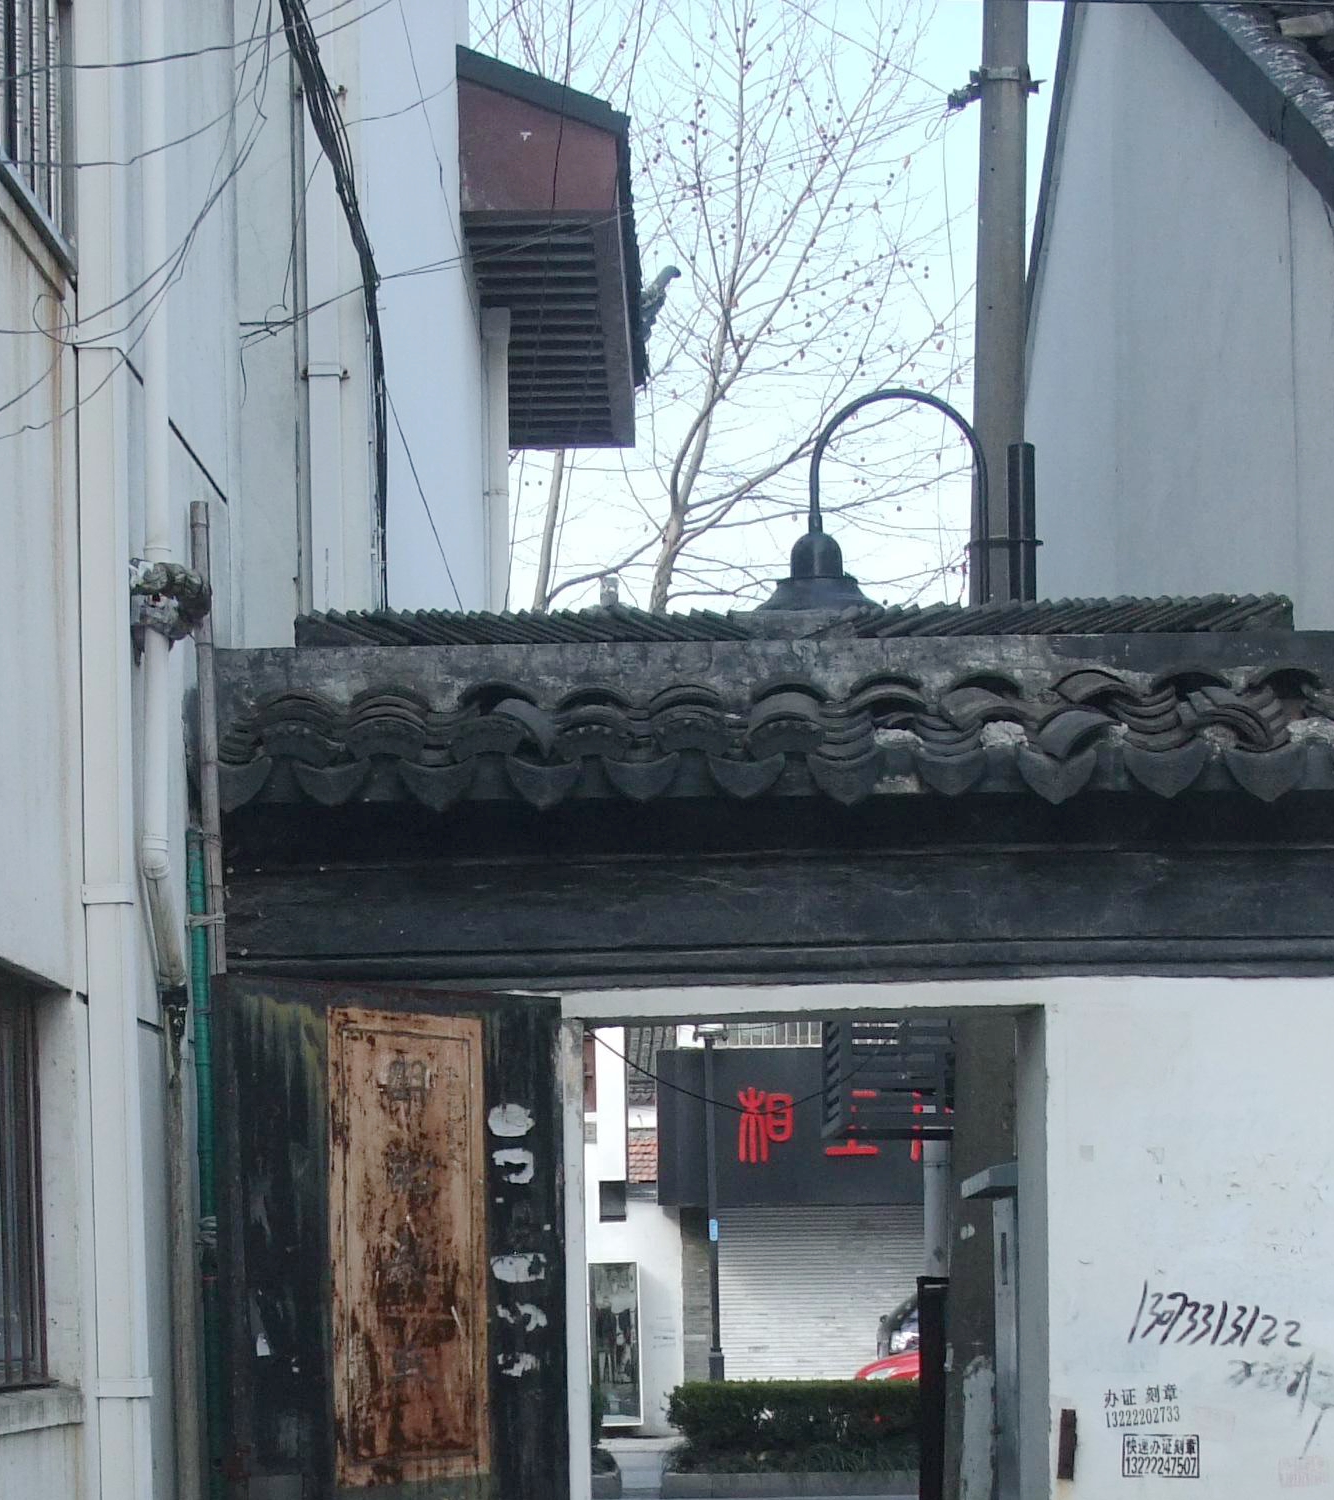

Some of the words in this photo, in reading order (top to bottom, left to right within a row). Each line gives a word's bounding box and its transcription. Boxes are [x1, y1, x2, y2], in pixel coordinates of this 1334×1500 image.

[1103, 1388, 1138, 1408] 办证
[1145, 1382, 1179, 1404] 刻章
[1104, 1404, 1181, 1428] 13222202733
[1125, 1436, 1197, 1455] 快速办证刻章
[1125, 1456, 1197, 1475] 13222247507
